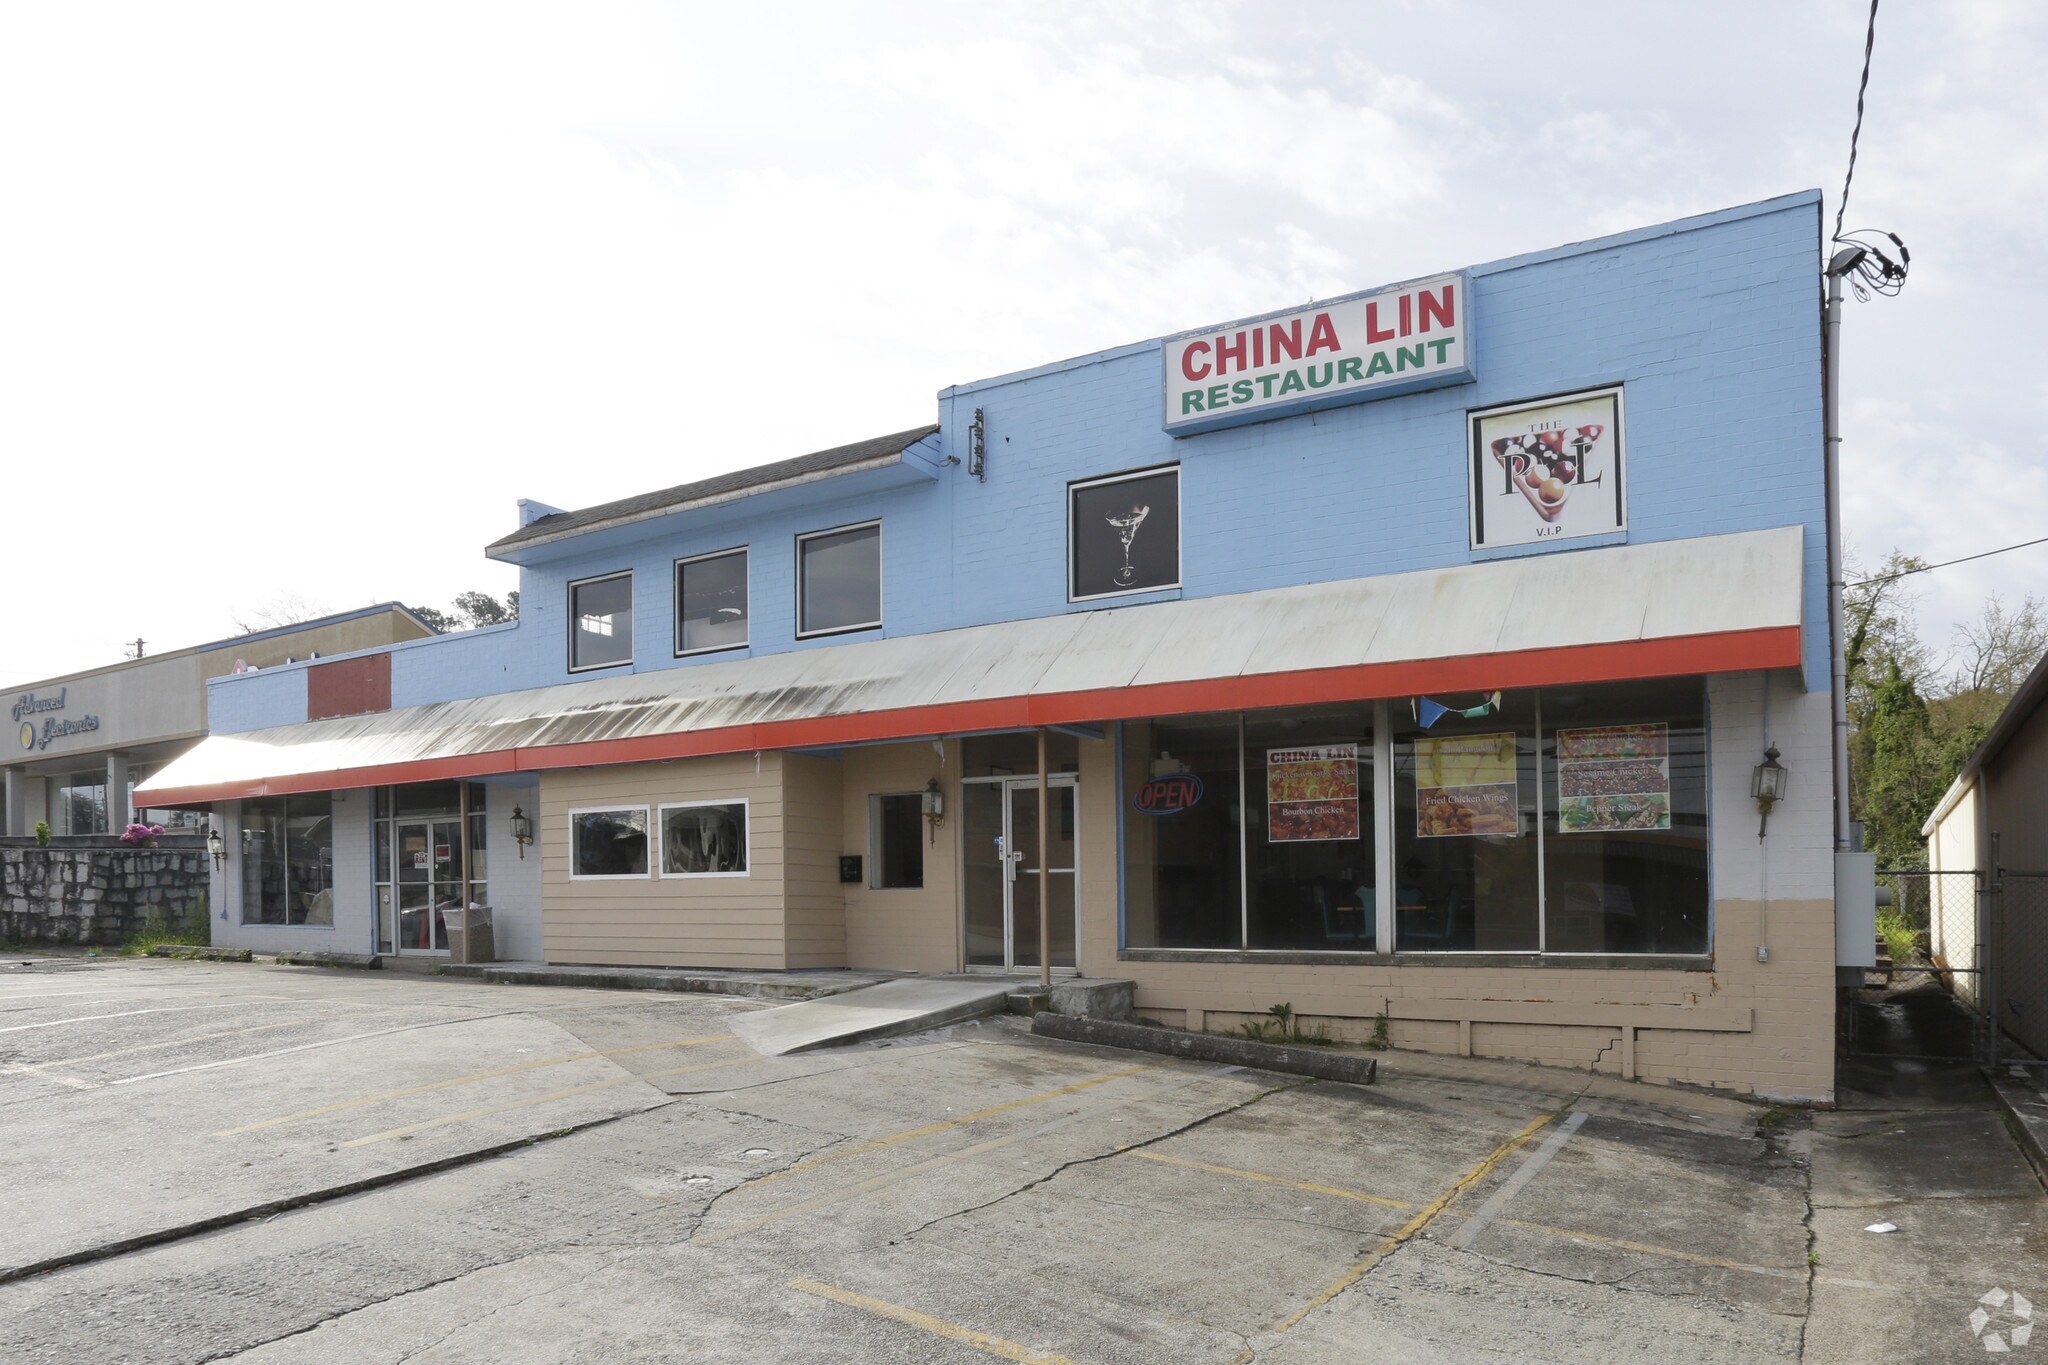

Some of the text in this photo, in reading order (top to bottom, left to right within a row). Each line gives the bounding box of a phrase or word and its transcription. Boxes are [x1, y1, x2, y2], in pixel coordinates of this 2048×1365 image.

[1181, 284, 1455, 382] CHINA LIN
[1181, 336, 1456, 416] RESTAURANT
[1527, 419, 1563, 433] THE
[12, 687, 67, 722] Advanced
[38, 714, 99, 750] Electronics
[1270, 747, 1354, 763] CHINA LIN
[1612, 767, 1649, 776] Chicken
[1138, 782, 1196, 809] OPEN
[1425, 793, 1509, 806] Fried Chicken Wings
[1282, 806, 1345, 816] Bourbon Chicken
[1586, 802, 1643, 815] Pepper Steak
